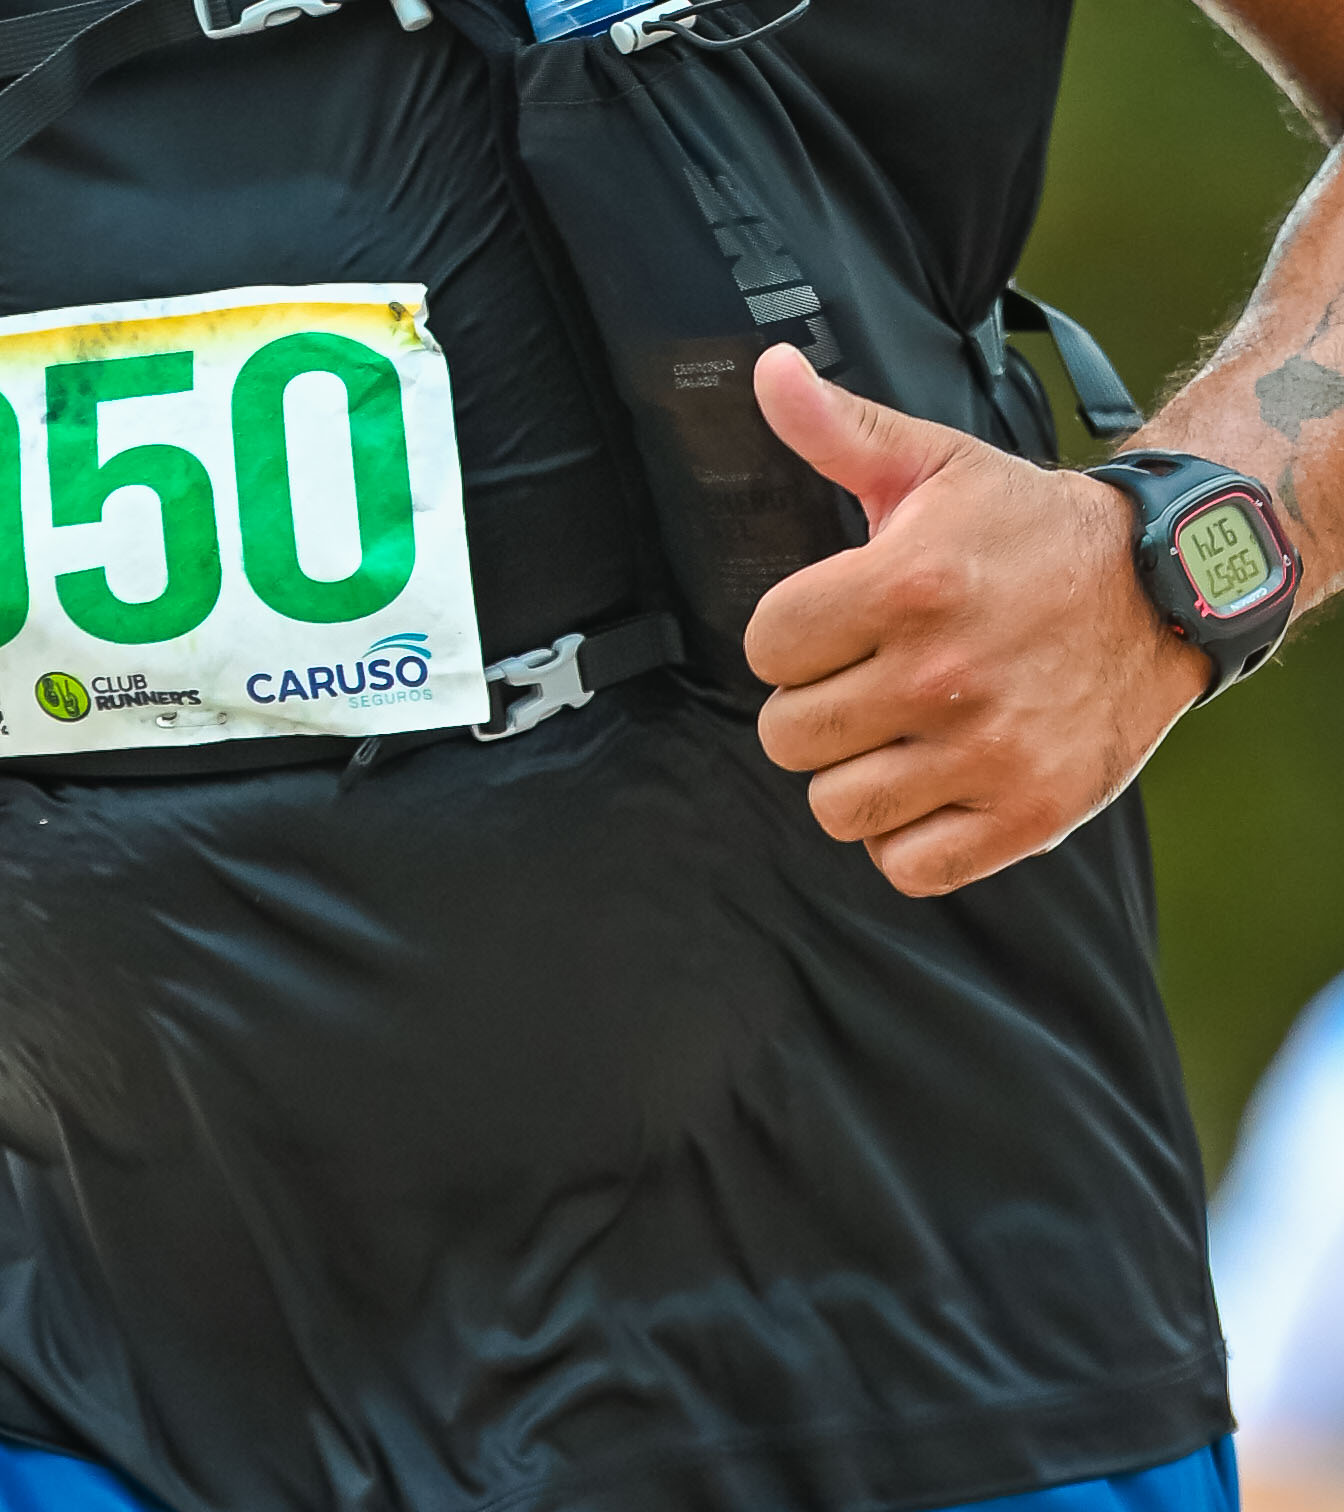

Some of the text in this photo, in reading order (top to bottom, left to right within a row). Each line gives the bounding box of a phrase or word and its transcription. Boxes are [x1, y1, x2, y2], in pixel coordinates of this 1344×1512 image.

[1192, 518, 1238, 561] 9.74
[1205, 548, 1259, 599] 59:57
[91, 674, 148, 694] CLUB
[246, 655, 428, 704] CARUSO
[347, 689, 433, 709] SEGUROS
